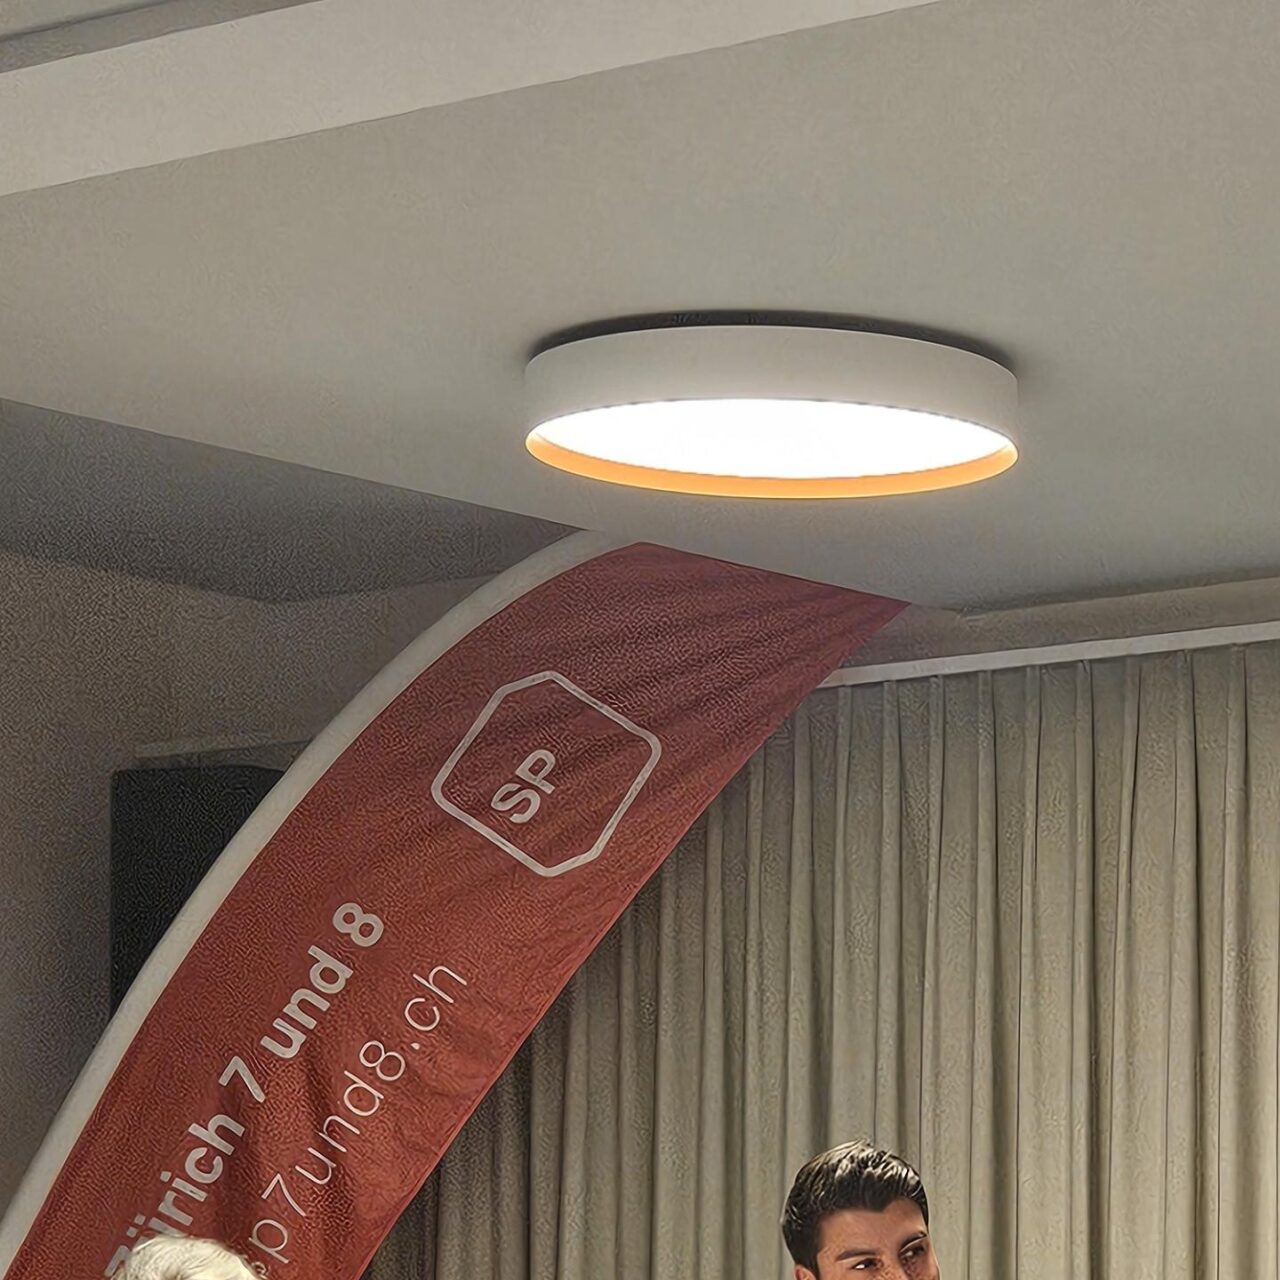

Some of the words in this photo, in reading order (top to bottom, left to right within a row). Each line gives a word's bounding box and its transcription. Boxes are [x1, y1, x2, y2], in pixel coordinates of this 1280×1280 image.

[490, 748, 556, 824] SP
[218, 1055, 266, 1103] 7
[259, 944, 354, 1059] und
[332, 902, 385, 947] 8
